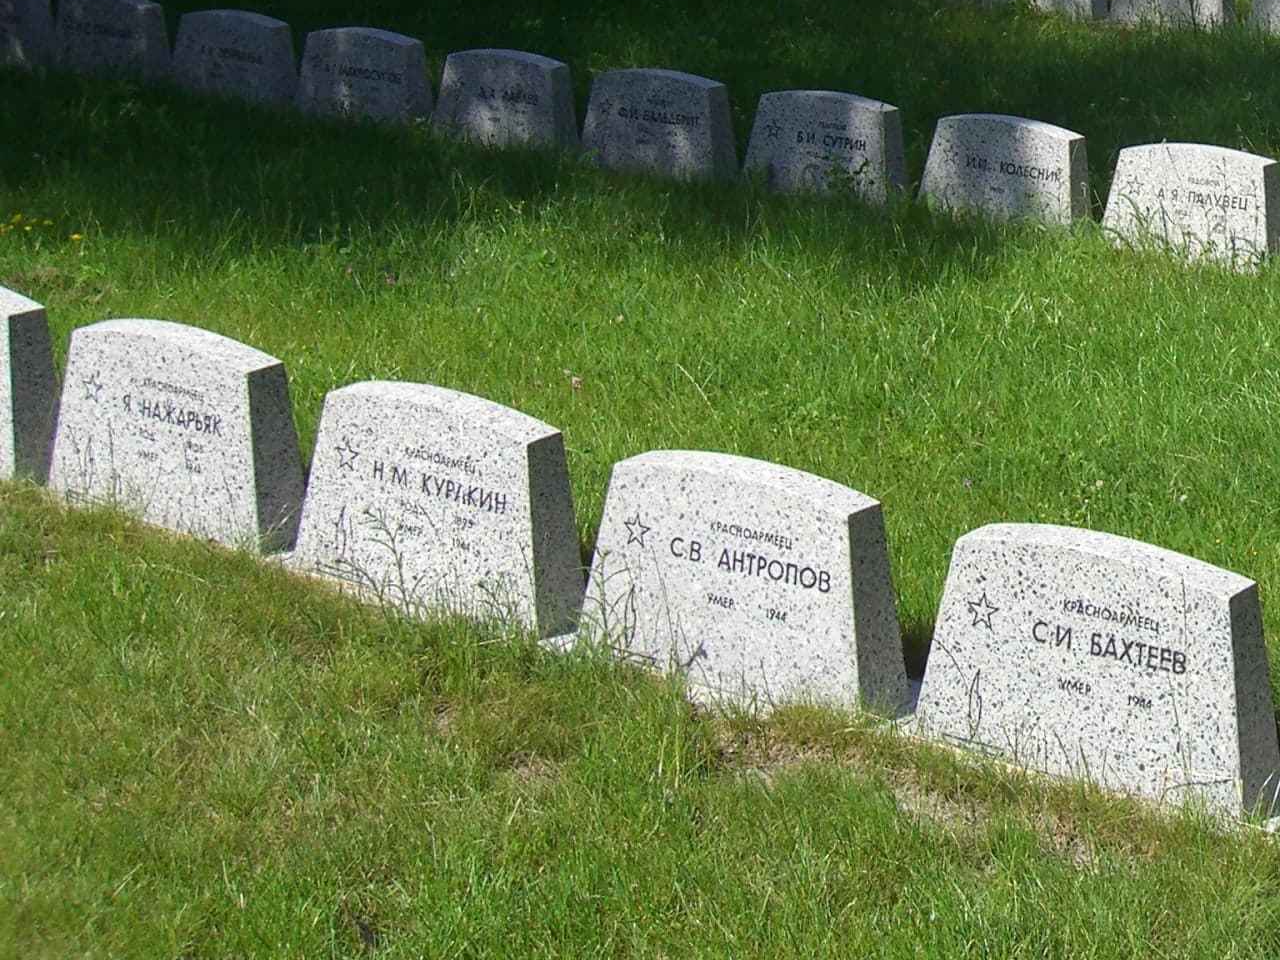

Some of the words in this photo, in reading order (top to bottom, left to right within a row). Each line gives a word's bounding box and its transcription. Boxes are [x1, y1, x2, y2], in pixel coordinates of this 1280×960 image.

[822, 135, 867, 150] СУТРИН
[1188, 190, 1248, 211] ПАЛУВЕЦ
[142, 398, 223, 438] НАЖАРЬЯК
[709, 521, 793, 551] КРАСНОАРМЕЕЦ
[717, 548, 831, 594] АНТРОПОВ
[1062, 600, 1160, 634] КРАСНОАРМЕЕЦ
[1090, 631, 1188, 675] БАХТЕЕВ
[1060, 678, 1092, 696] УМЕР
